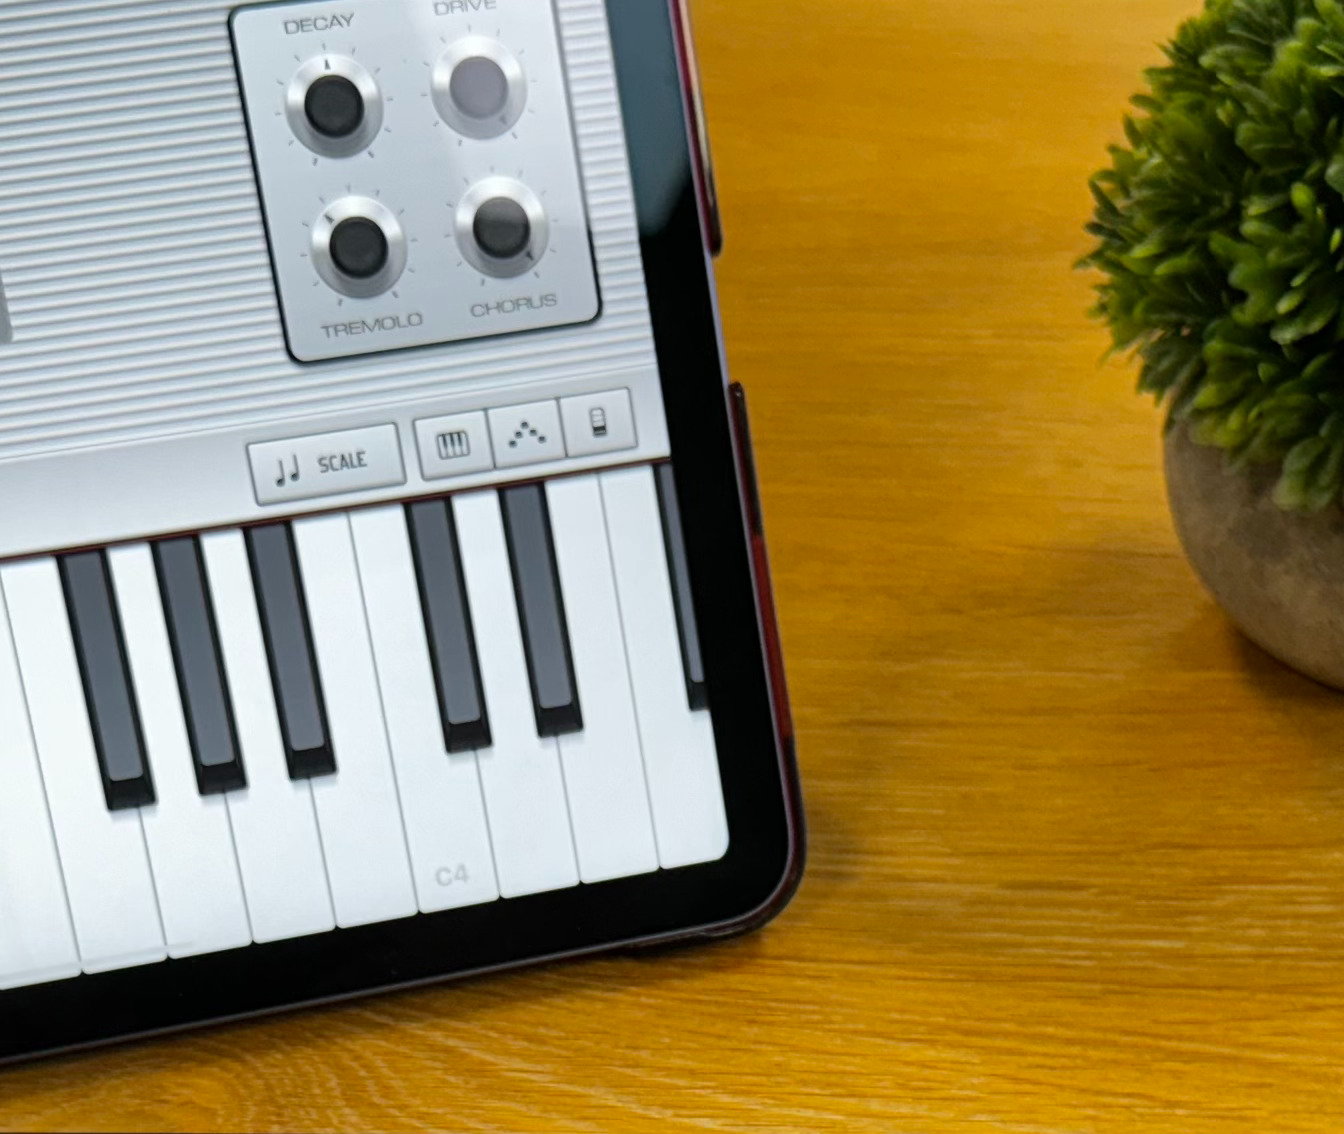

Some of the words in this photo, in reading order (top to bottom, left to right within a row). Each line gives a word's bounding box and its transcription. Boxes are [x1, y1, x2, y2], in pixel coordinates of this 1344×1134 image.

[284, 13, 355, 35] DECAY
[470, 293, 558, 319] CHORUS
[321, 312, 424, 340] TREMOLO
[317, 450, 369, 474] SCALE
[435, 864, 470, 888] C4
